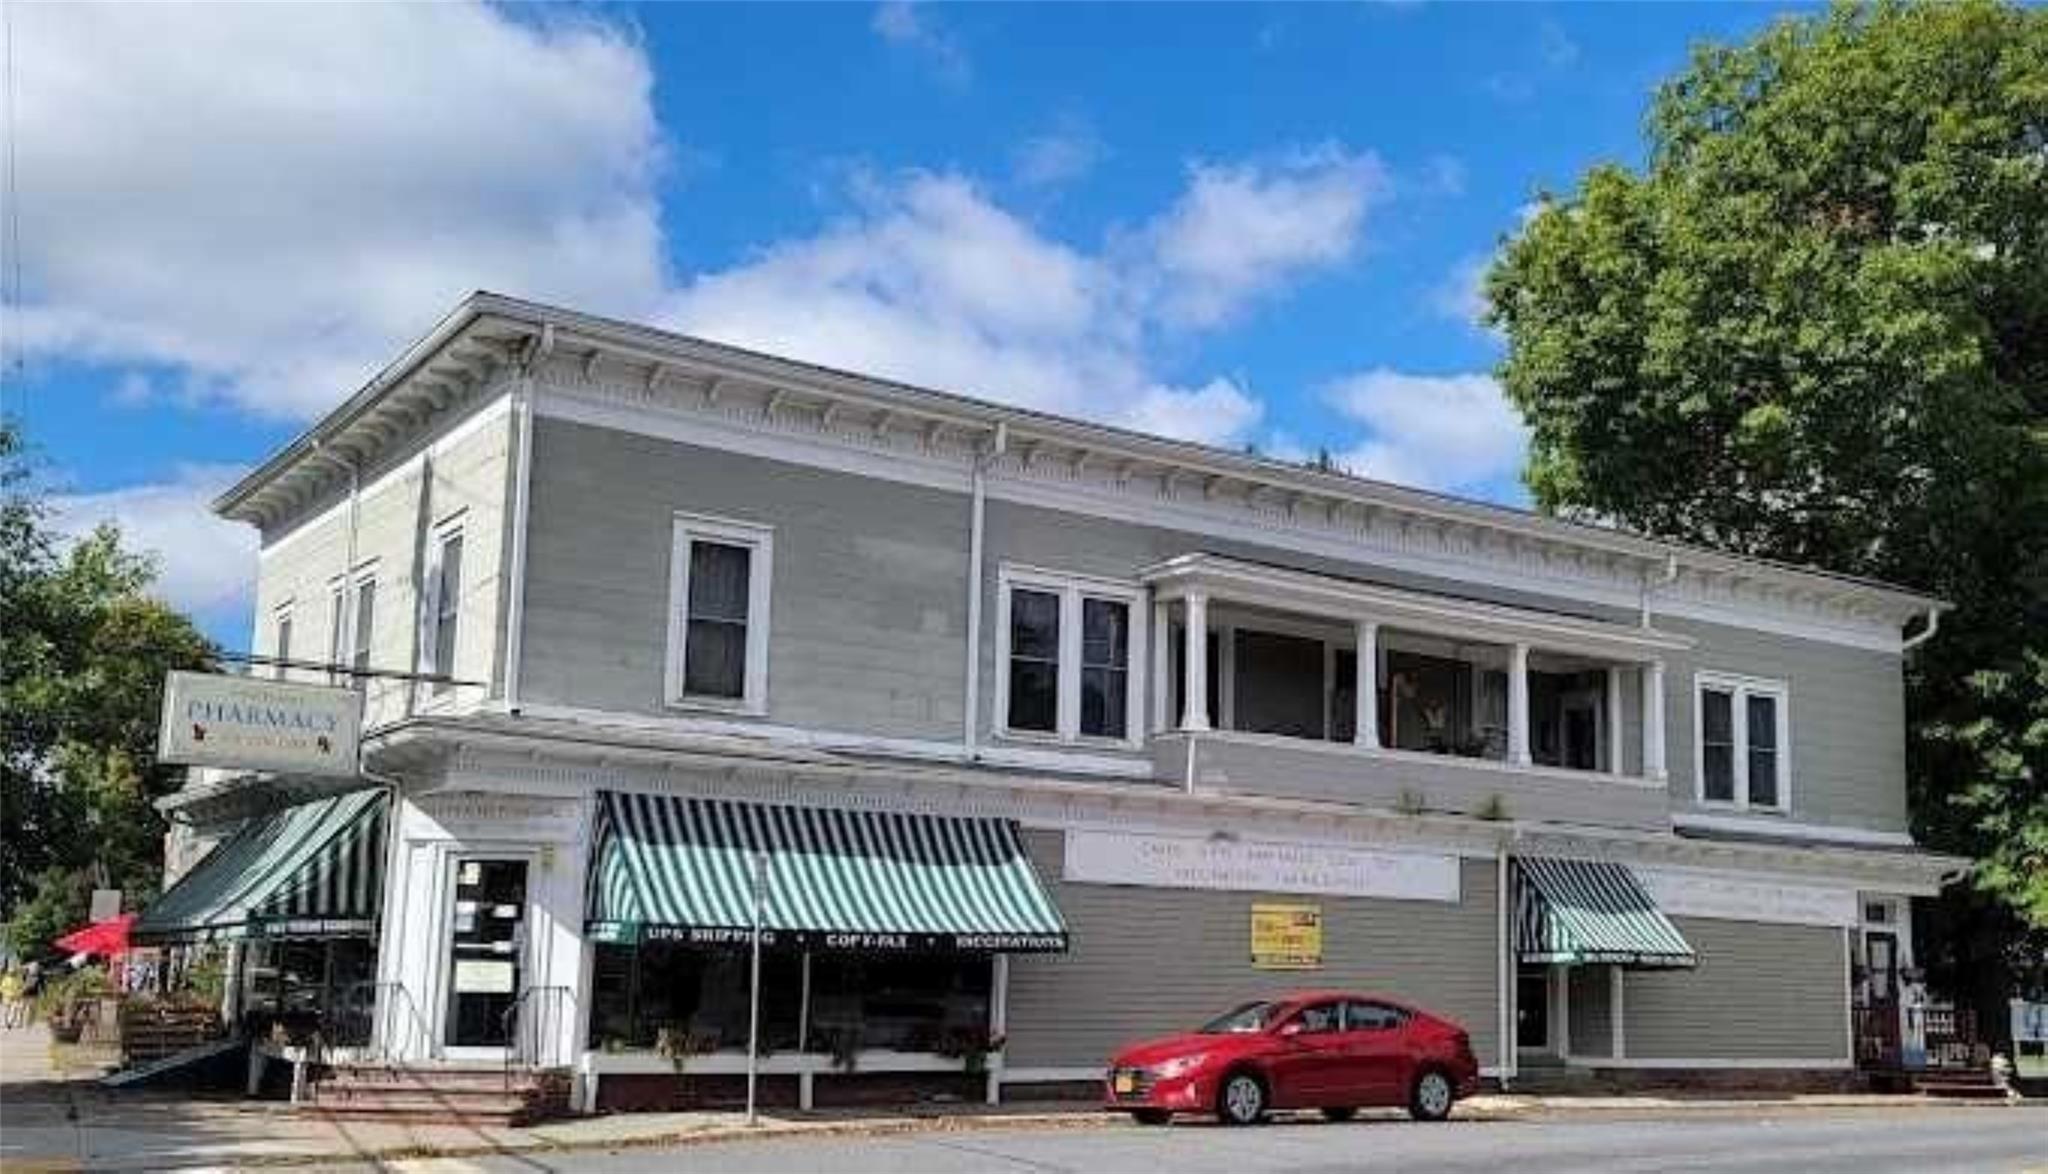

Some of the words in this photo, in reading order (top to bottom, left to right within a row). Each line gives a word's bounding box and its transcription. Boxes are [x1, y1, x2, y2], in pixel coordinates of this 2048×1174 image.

[188, 701, 337, 732] PHARMACY
[648, 928, 683, 941] UPS
[690, 928, 776, 944] SHIPPIG
